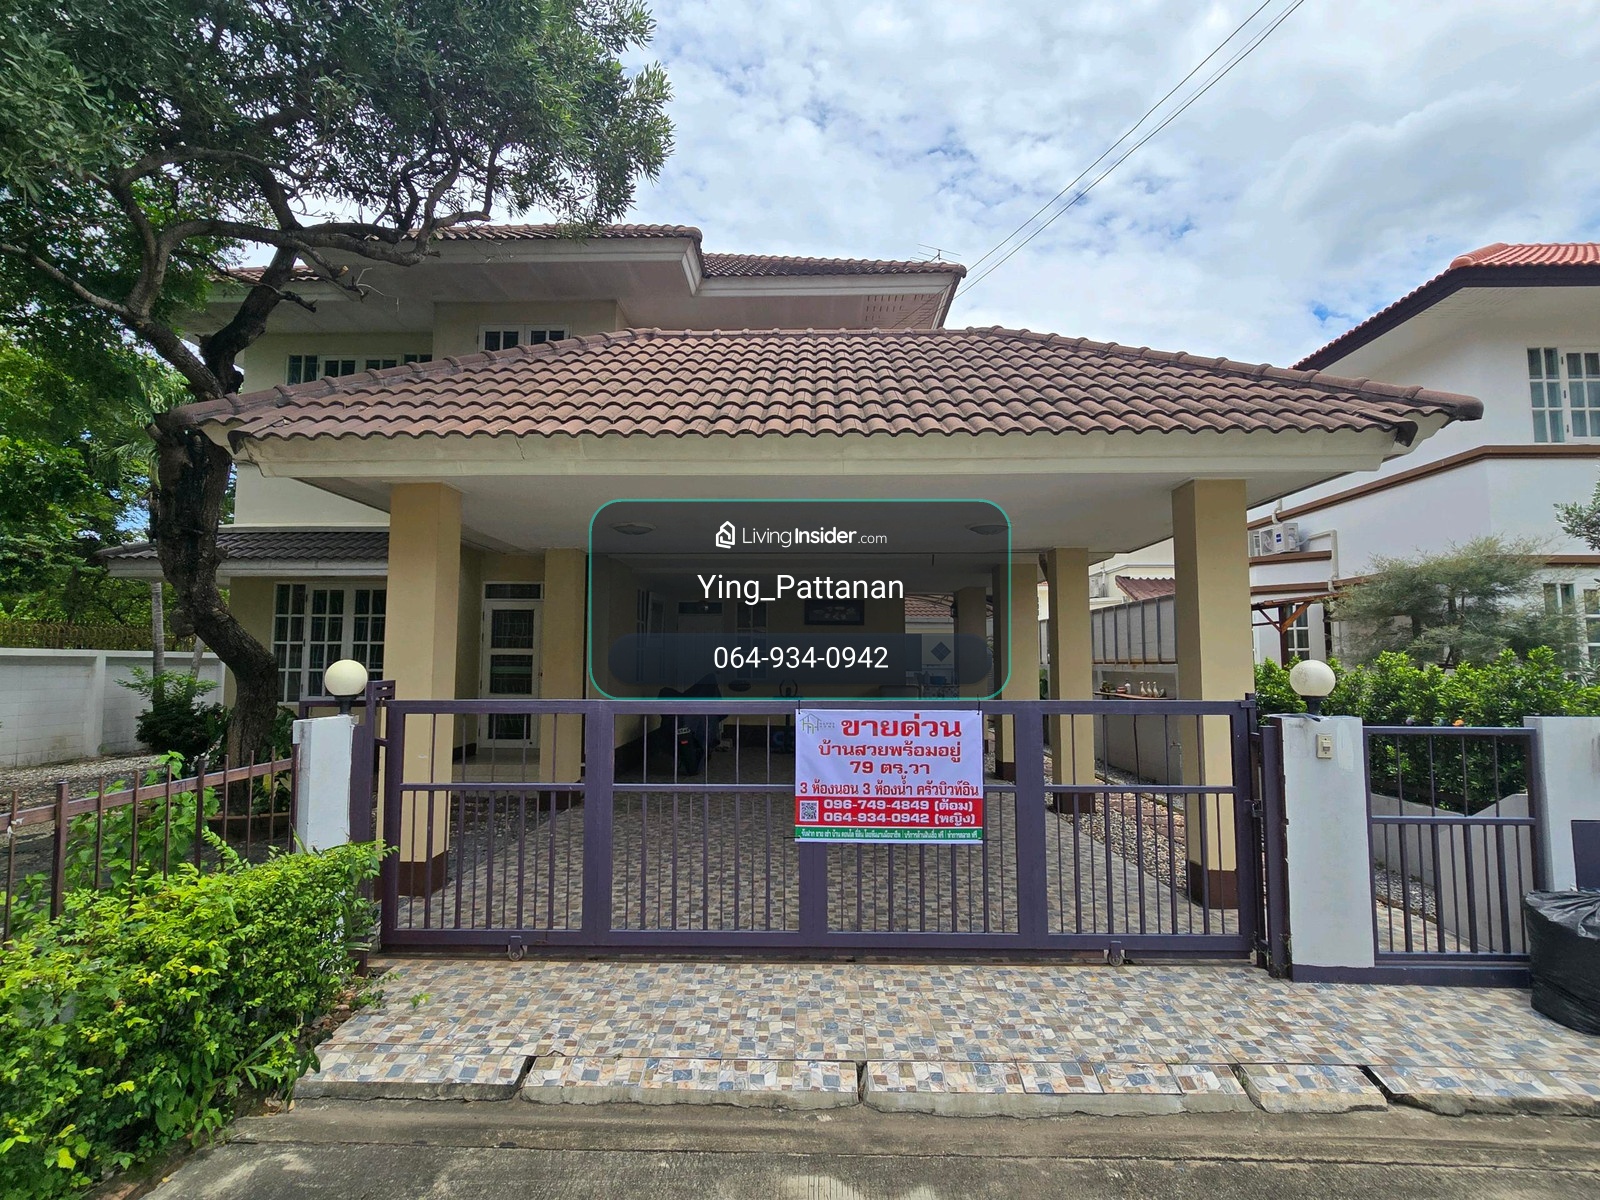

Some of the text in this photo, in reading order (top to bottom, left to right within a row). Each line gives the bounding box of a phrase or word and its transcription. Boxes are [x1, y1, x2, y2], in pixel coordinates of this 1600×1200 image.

[841, 713, 962, 737] ขายด่วน
[818, 739, 961, 763] บ้านสวยพร้อมอยู่
[850, 761, 930, 775] 79 ตร.วา
[800, 782, 807, 794] 3
[812, 779, 859, 795] ห้องนอน
[863, 783, 870, 795] 3
[874, 775, 913, 796] ห้องน้ำ
[823, 799, 930, 811] 096-749-4849
[823, 812, 930, 824] 064-934-0942
